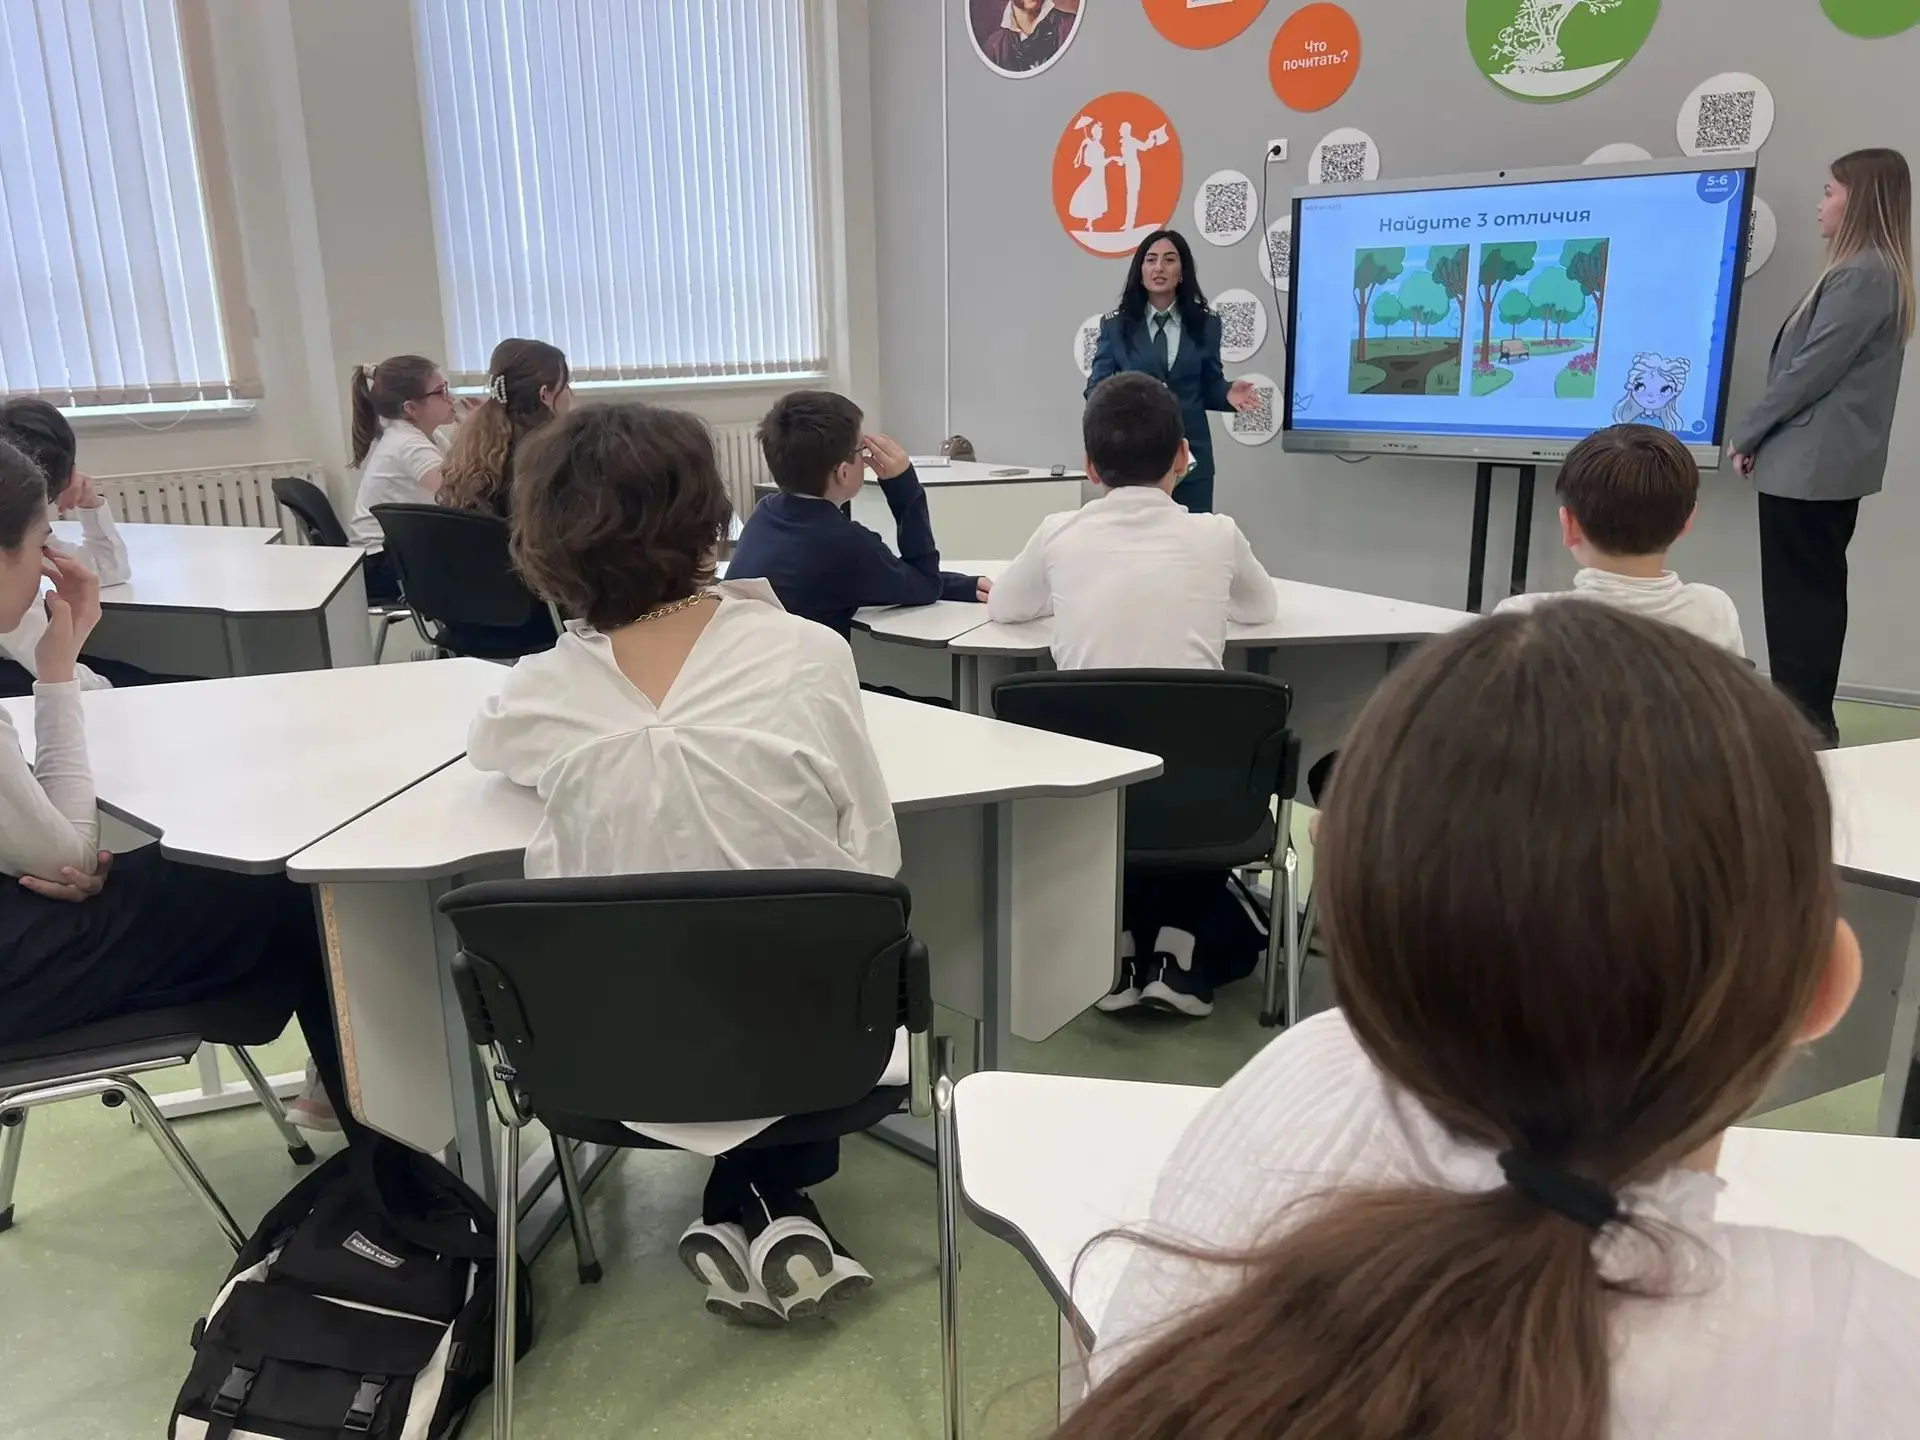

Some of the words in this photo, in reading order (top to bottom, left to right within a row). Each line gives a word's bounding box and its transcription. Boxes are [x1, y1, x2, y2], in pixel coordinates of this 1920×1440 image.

[1304, 40, 1327, 53] Что
[1282, 49, 1349, 71] почитать?
[1706, 174, 1729, 186] 5-6
[1379, 216, 1471, 234] Найдите
[1477, 212, 1488, 227] 3
[1493, 209, 1591, 226] отличия
